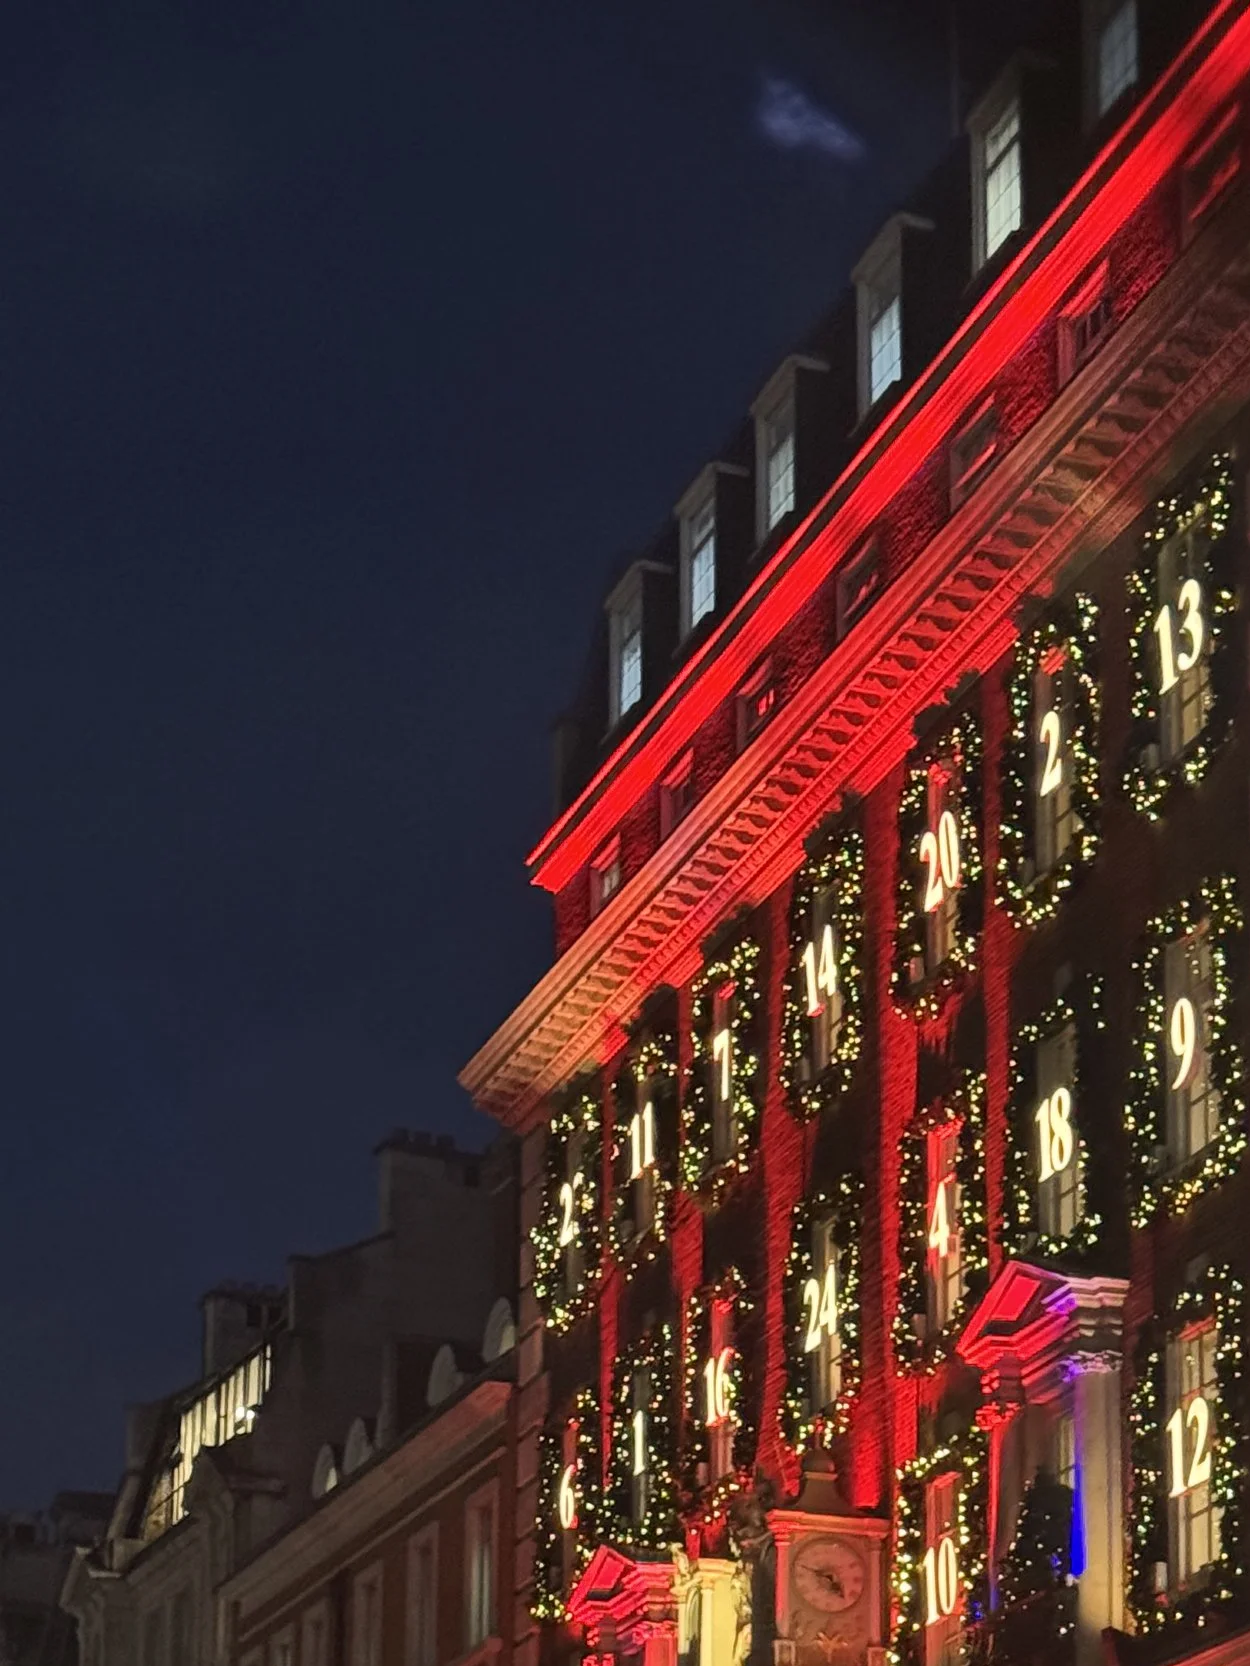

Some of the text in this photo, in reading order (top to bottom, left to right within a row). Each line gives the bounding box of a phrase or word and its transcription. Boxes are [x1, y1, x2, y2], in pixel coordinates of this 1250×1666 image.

[1154, 578, 1203, 696] 13
[1039, 710, 1063, 798] 2
[919, 810, 959, 914] 20
[801, 924, 839, 1014] 14
[711, 1027, 731, 1101] 7
[1170, 997, 1196, 1092] 9
[629, 1100, 655, 1180] 11
[1034, 1087, 1073, 1183] 18
[559, 1171, 585, 1248] 2
[927, 1180, 951, 1258] 4
[803, 1263, 838, 1355] 24
[702, 1346, 734, 1427] 16
[631, 1408, 646, 1476] 1
[1165, 1396, 1212, 1499] 12
[559, 1463, 577, 1529] 6
[923, 1536, 958, 1626] 10
